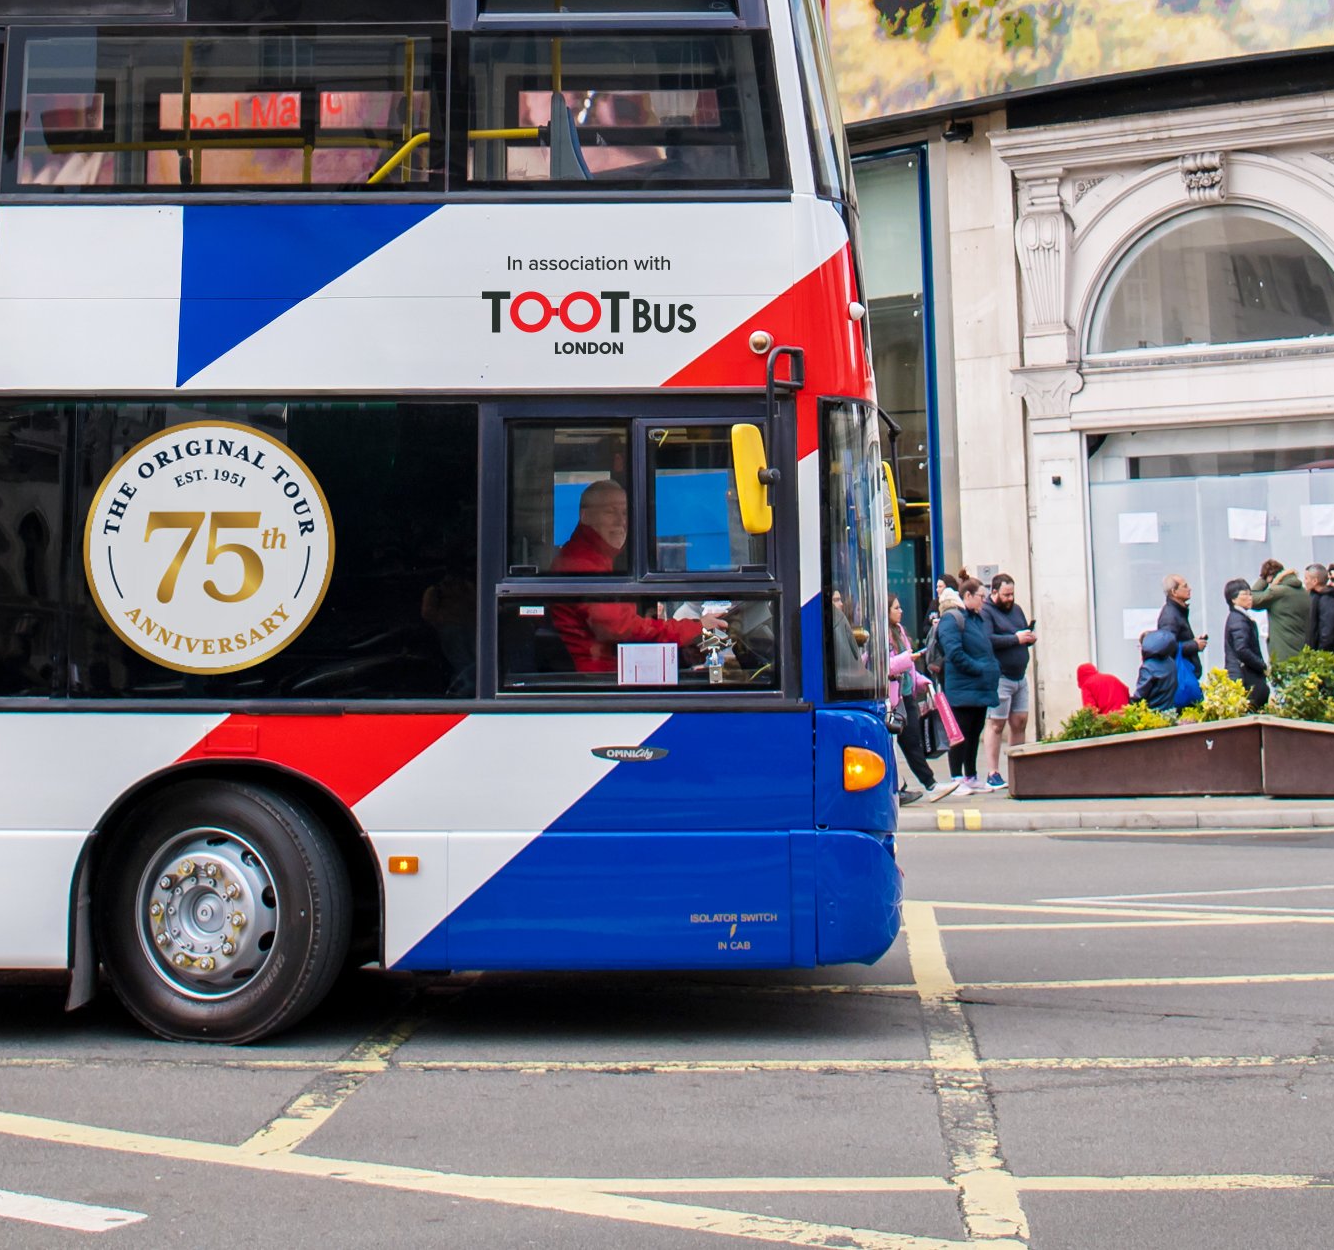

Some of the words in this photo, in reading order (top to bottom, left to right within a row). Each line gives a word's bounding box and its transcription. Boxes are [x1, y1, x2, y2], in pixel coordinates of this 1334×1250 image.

[507, 256, 523, 271] In
[528, 256, 630, 271] association
[634, 255, 671, 271] with
[554, 341, 624, 355] LONDON
[174, 468, 208, 488] EST.
[213, 468, 247, 488] 1951
[103, 482, 138, 536] THE
[137, 439, 266, 480] ORIGINAL
[271, 466, 315, 537] TOUR
[123, 603, 291, 655] ANNIVERSARY
[689, 913, 737, 923] ISOLATOR
[740, 912, 778, 923] SWITCH
[717, 941, 727, 950] IN
